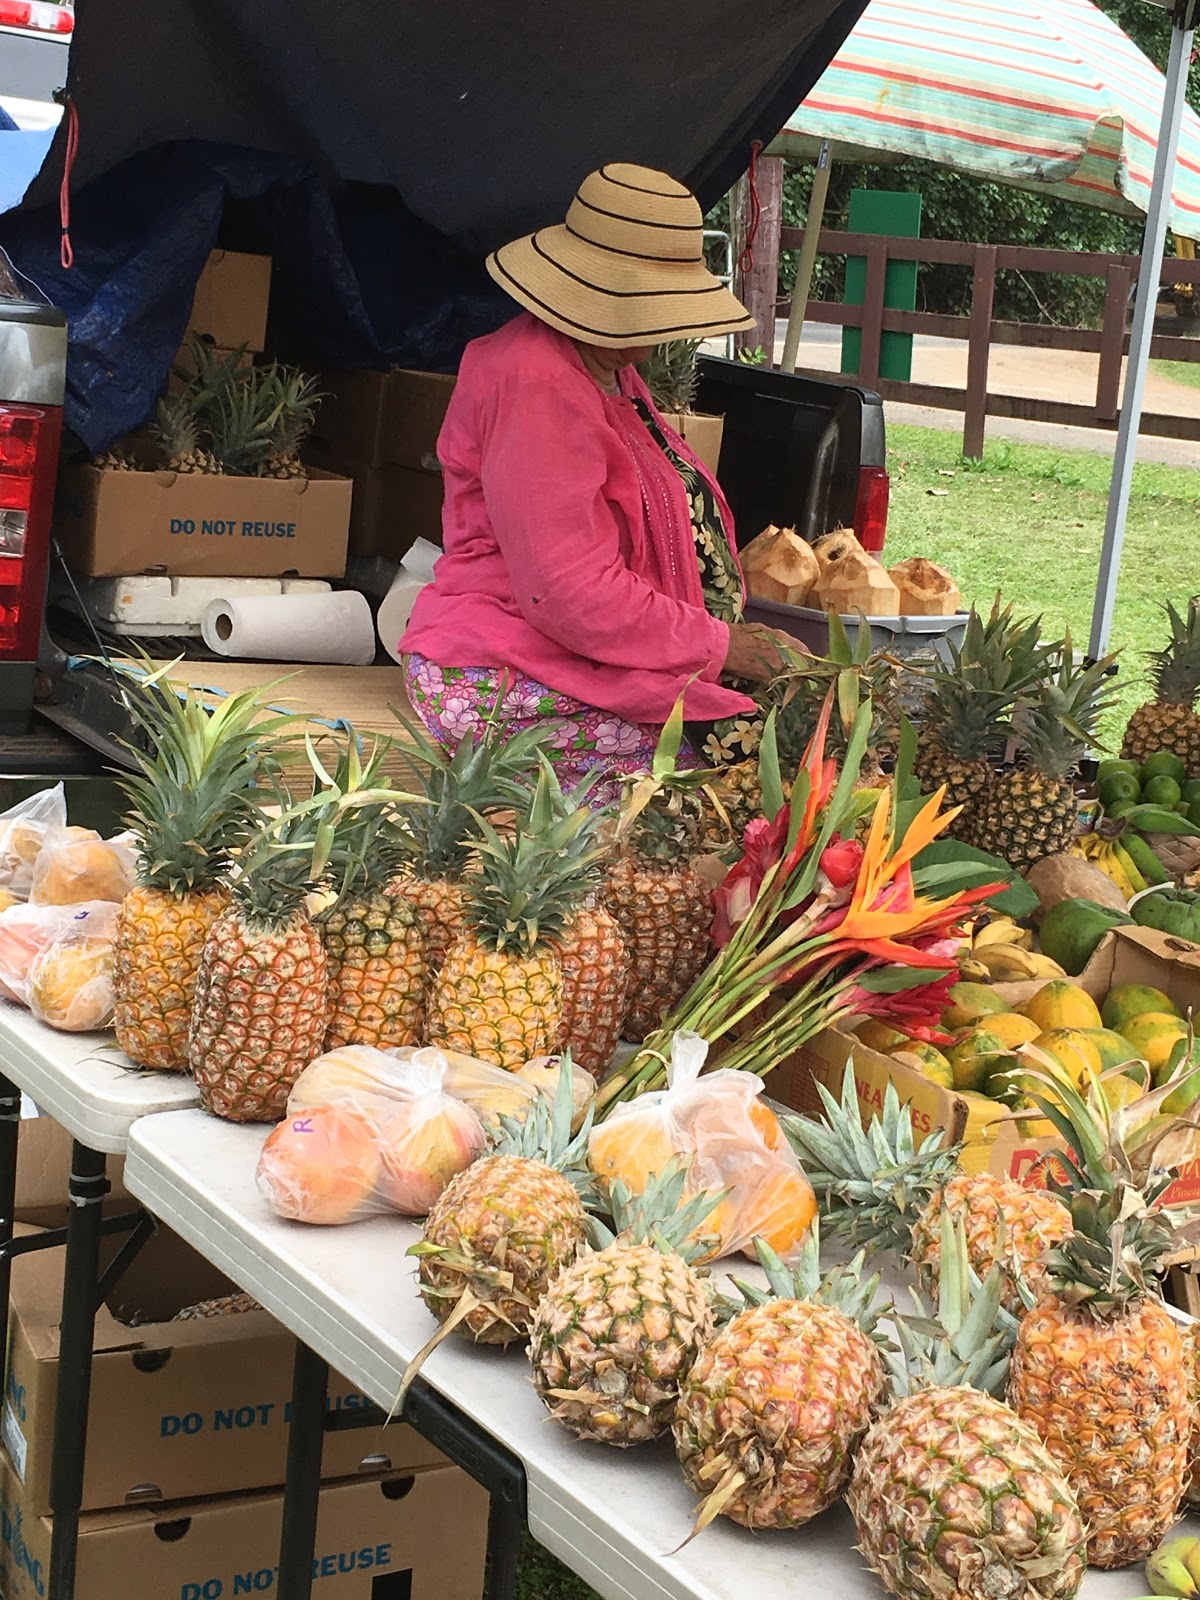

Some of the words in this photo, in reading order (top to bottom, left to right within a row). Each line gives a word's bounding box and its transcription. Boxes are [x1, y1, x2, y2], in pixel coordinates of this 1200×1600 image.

[170, 519, 196, 535] DO
[201, 520, 237, 536] NOT
[241, 521, 297, 538] REUSE
[160, 1412, 204, 1437] DO
[214, 1403, 275, 1431] NOT
[181, 1578, 223, 1600] DO
[233, 1566, 280, 1595] NO
